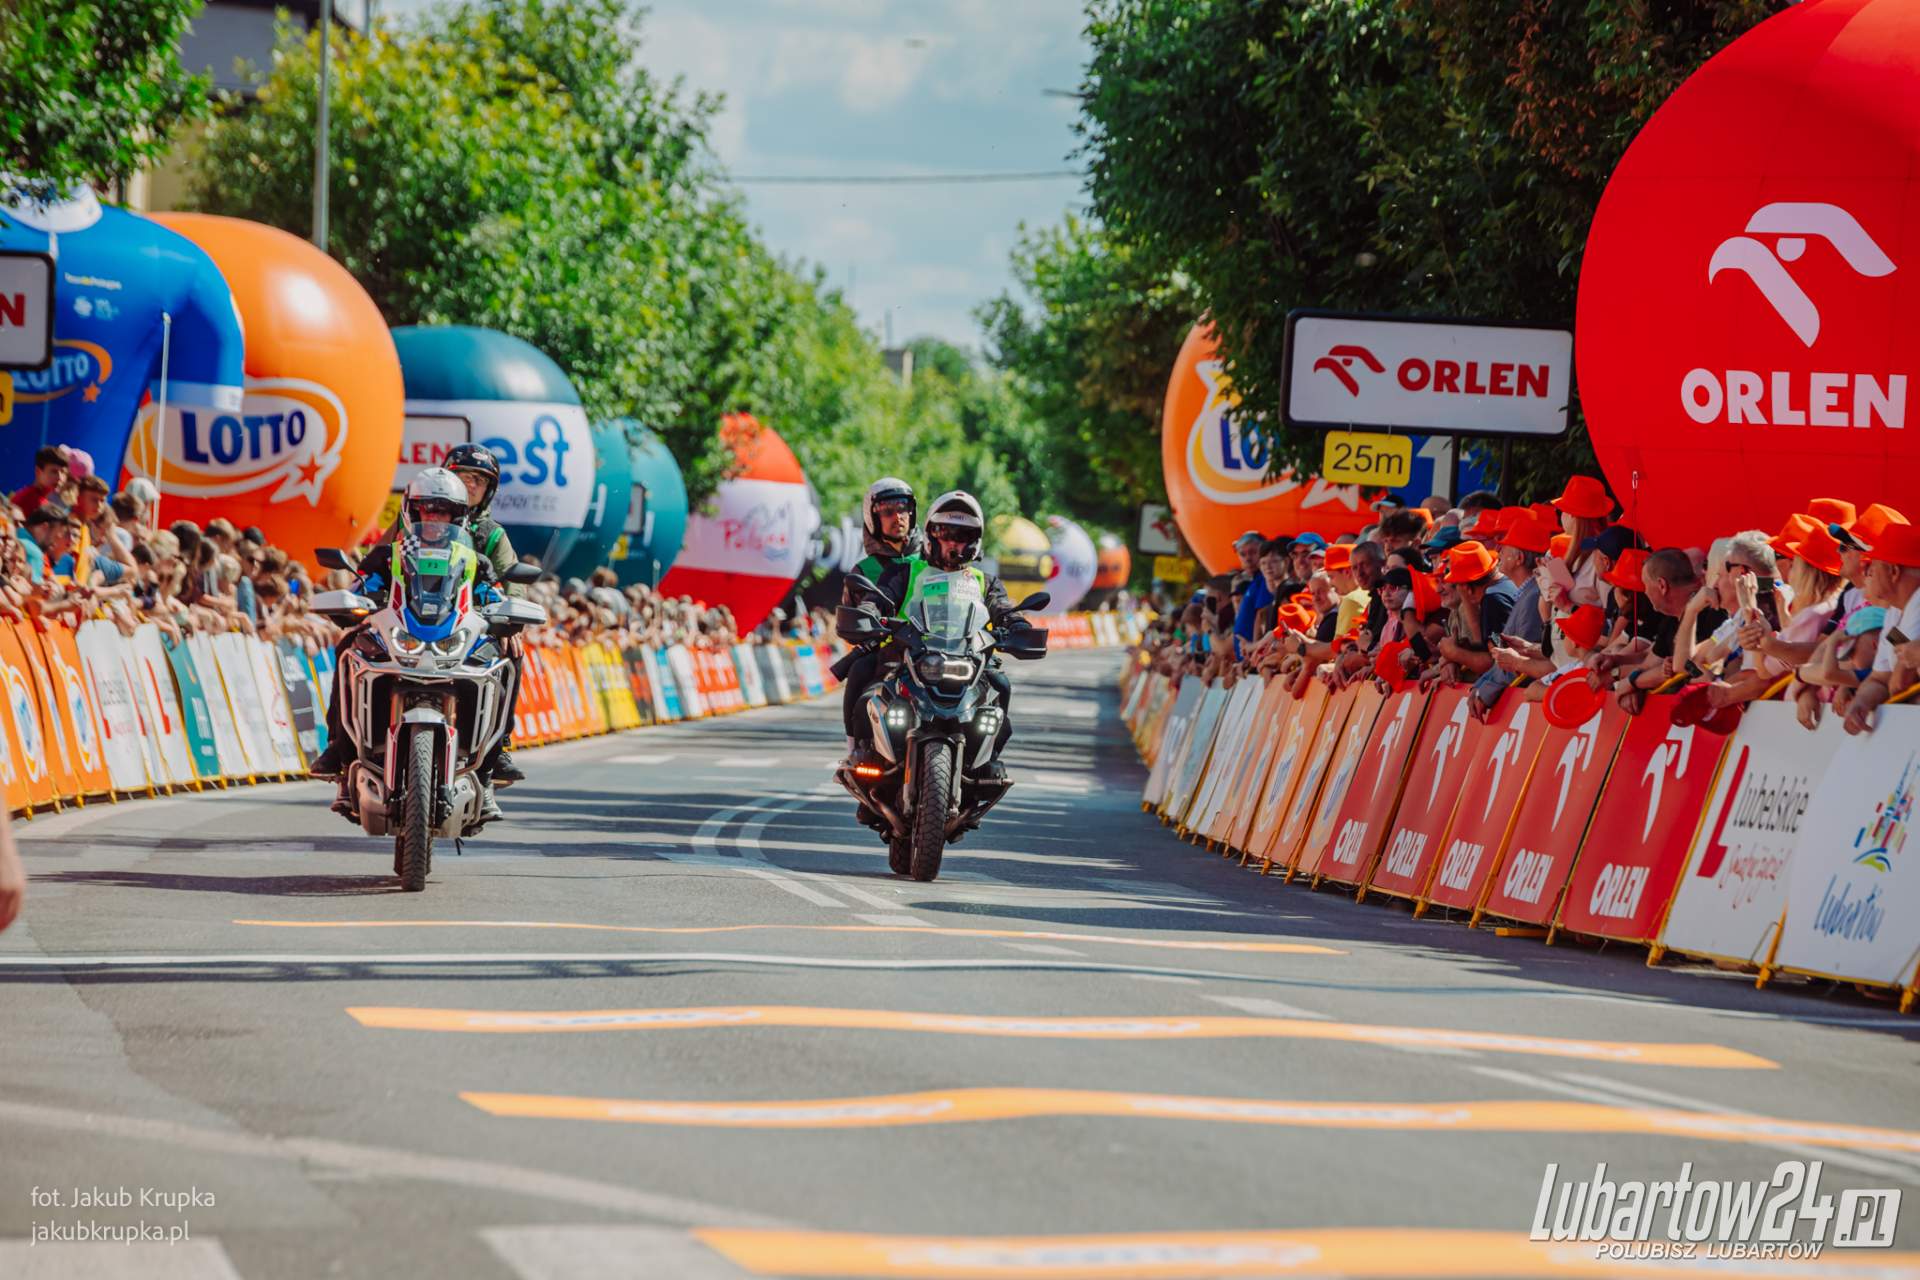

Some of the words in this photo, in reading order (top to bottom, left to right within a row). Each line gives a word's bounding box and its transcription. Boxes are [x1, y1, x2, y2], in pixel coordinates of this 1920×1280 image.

[1397, 358, 1549, 398] ORLEN
[1681, 367, 1907, 429] ORLEN
[180, 409, 306, 466] LOTTO
[1332, 442, 1403, 475] 25m
[1386, 828, 1429, 879] ORLEN
[1439, 839, 1485, 891] ORLEN
[1503, 848, 1555, 905] ORLEN
[1589, 863, 1651, 920] ORLEN
